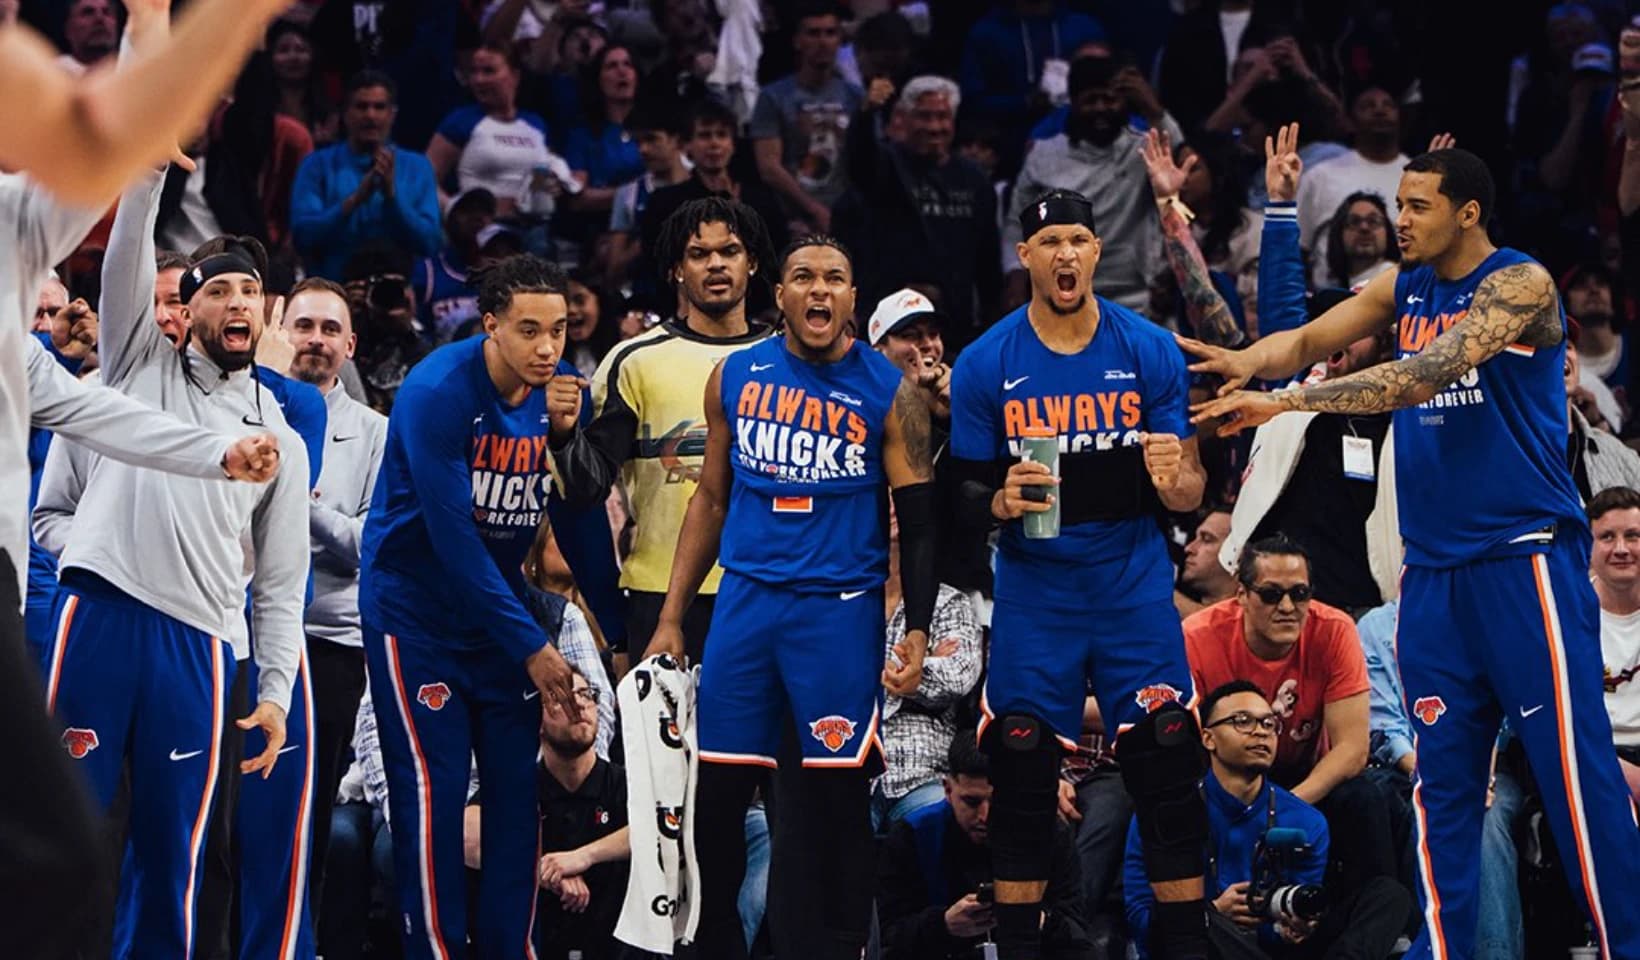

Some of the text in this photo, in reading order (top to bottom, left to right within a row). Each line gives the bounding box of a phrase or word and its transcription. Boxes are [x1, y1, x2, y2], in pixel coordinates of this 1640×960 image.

[737, 380, 868, 444] ALWAYS
[1003, 390, 1141, 438] ALWAYS
[472, 433, 551, 473] LWAY
[736, 417, 866, 472] KNICKS
[471, 470, 553, 511] NICKS
